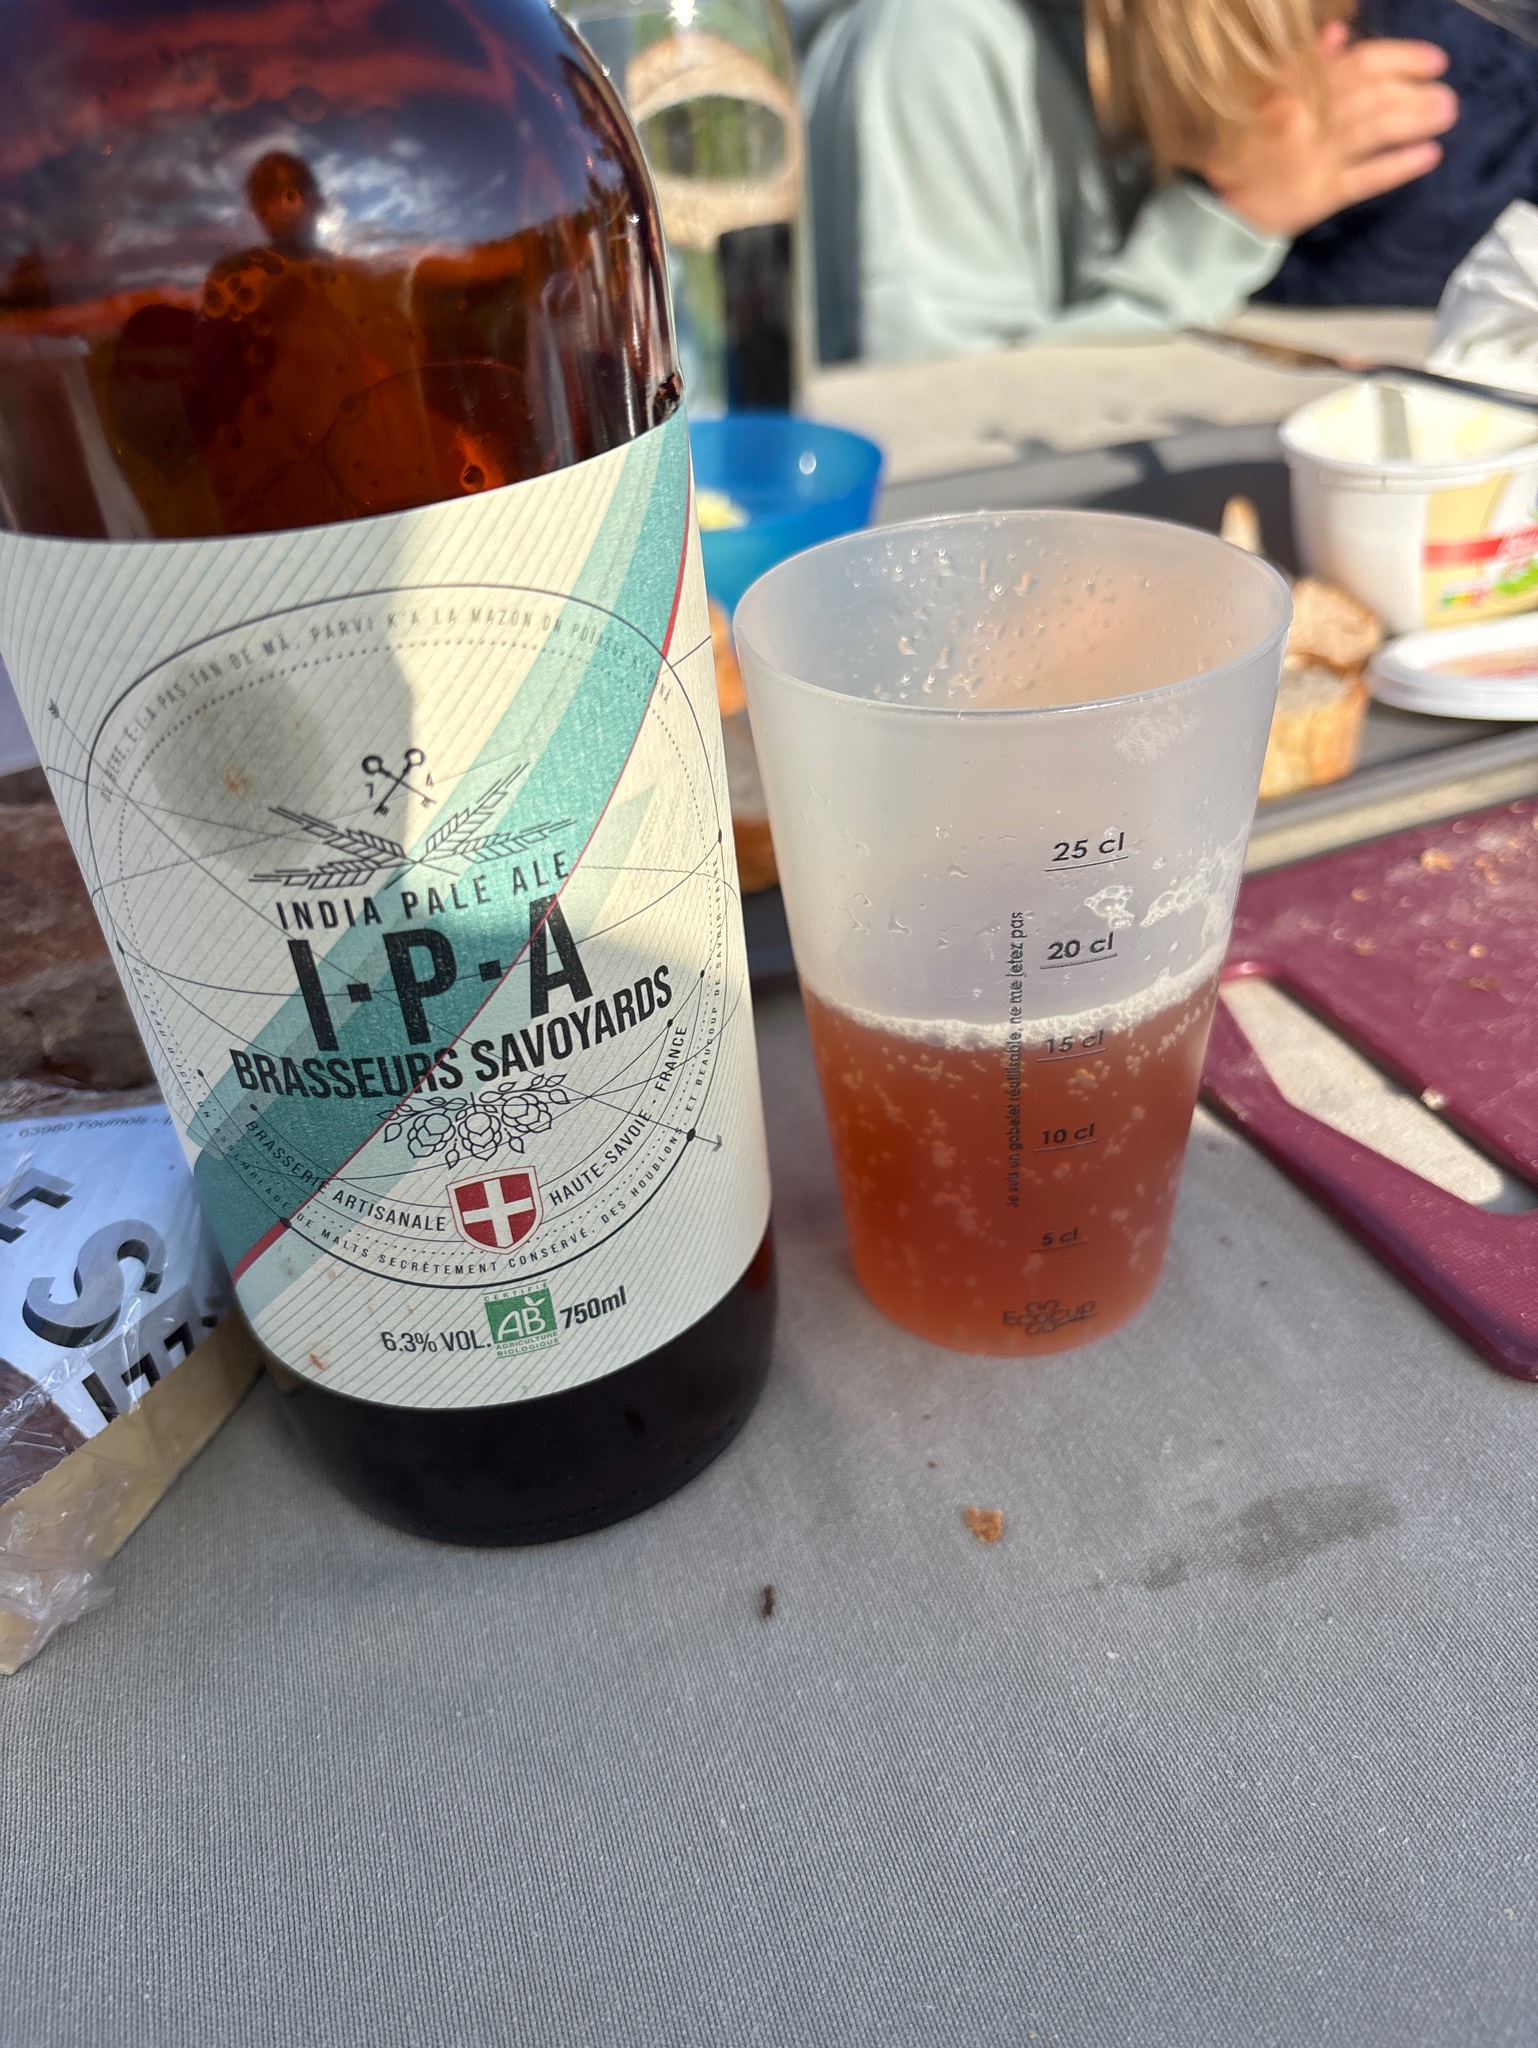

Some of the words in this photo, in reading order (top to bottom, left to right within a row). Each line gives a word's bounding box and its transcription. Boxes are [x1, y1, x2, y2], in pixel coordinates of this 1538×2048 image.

[157, 681, 188, 710] PAS
[189, 662, 223, 688] TAN
[310, 616, 375, 643] PARVI
[434, 608, 456, 626] LA
[471, 607, 532, 628] MAZON
[542, 615, 562, 633] ON
[365, 782, 374, 799] 7
[1052, 839, 1088, 861] 25
[1098, 831, 1125, 854] cl
[275, 895, 383, 931] INDIA
[401, 874, 491, 920] PALE
[512, 850, 570, 895] ALE
[1010, 911, 1027, 939] pas
[1005, 942, 1027, 977] jetez
[1047, 939, 1081, 960] 20
[1089, 931, 1114, 954] cl
[1009, 980, 1023, 1004] me
[1009, 1006, 1022, 1024] ne
[228, 1046, 464, 1100] BRASSEURS
[470, 964, 674, 1083] SAVOYARDS
[1045, 1036, 1073, 1053] 15
[1082, 1028, 1104, 1047] cl
[197, 1101, 212, 1118] UN
[297, 1212, 313, 1229] DE
[321, 1228, 369, 1258] MALTS
[378, 1254, 497, 1275] SECRÈTEMENT
[508, 1227, 596, 1268] CONSERVÉ,
[601, 1200, 627, 1224] DES
[686, 1095, 698, 1112] ET
[695, 1007, 718, 1086] BEAUCOUP
[714, 979, 721, 996] DE
[549, 1109, 653, 1206] HAUTE-SAVOIE
[654, 1026, 688, 1092] FRANCE
[1005, 1104, 1024, 1151] gobelet
[1042, 1128, 1067, 1145] 10
[1074, 1121, 1095, 1140] cl
[1008, 1153, 1020, 1168] un
[246, 1120, 331, 1195] BRASSERIE
[332, 1189, 447, 1232] ARTISANALE
[1005, 1171, 1020, 1192] suis
[1042, 1231, 1054, 1246] 5
[1060, 1226, 1079, 1243] cl
[559, 1285, 628, 1330] 750ml
[498, 1306, 546, 1341] AB
[381, 1330, 438, 1353] 6.3%
[441, 1329, 492, 1352] VOL.
[496, 1331, 559, 1350] AGRICULTURE
[496, 1337, 560, 1356] BIOLOGIQUE
